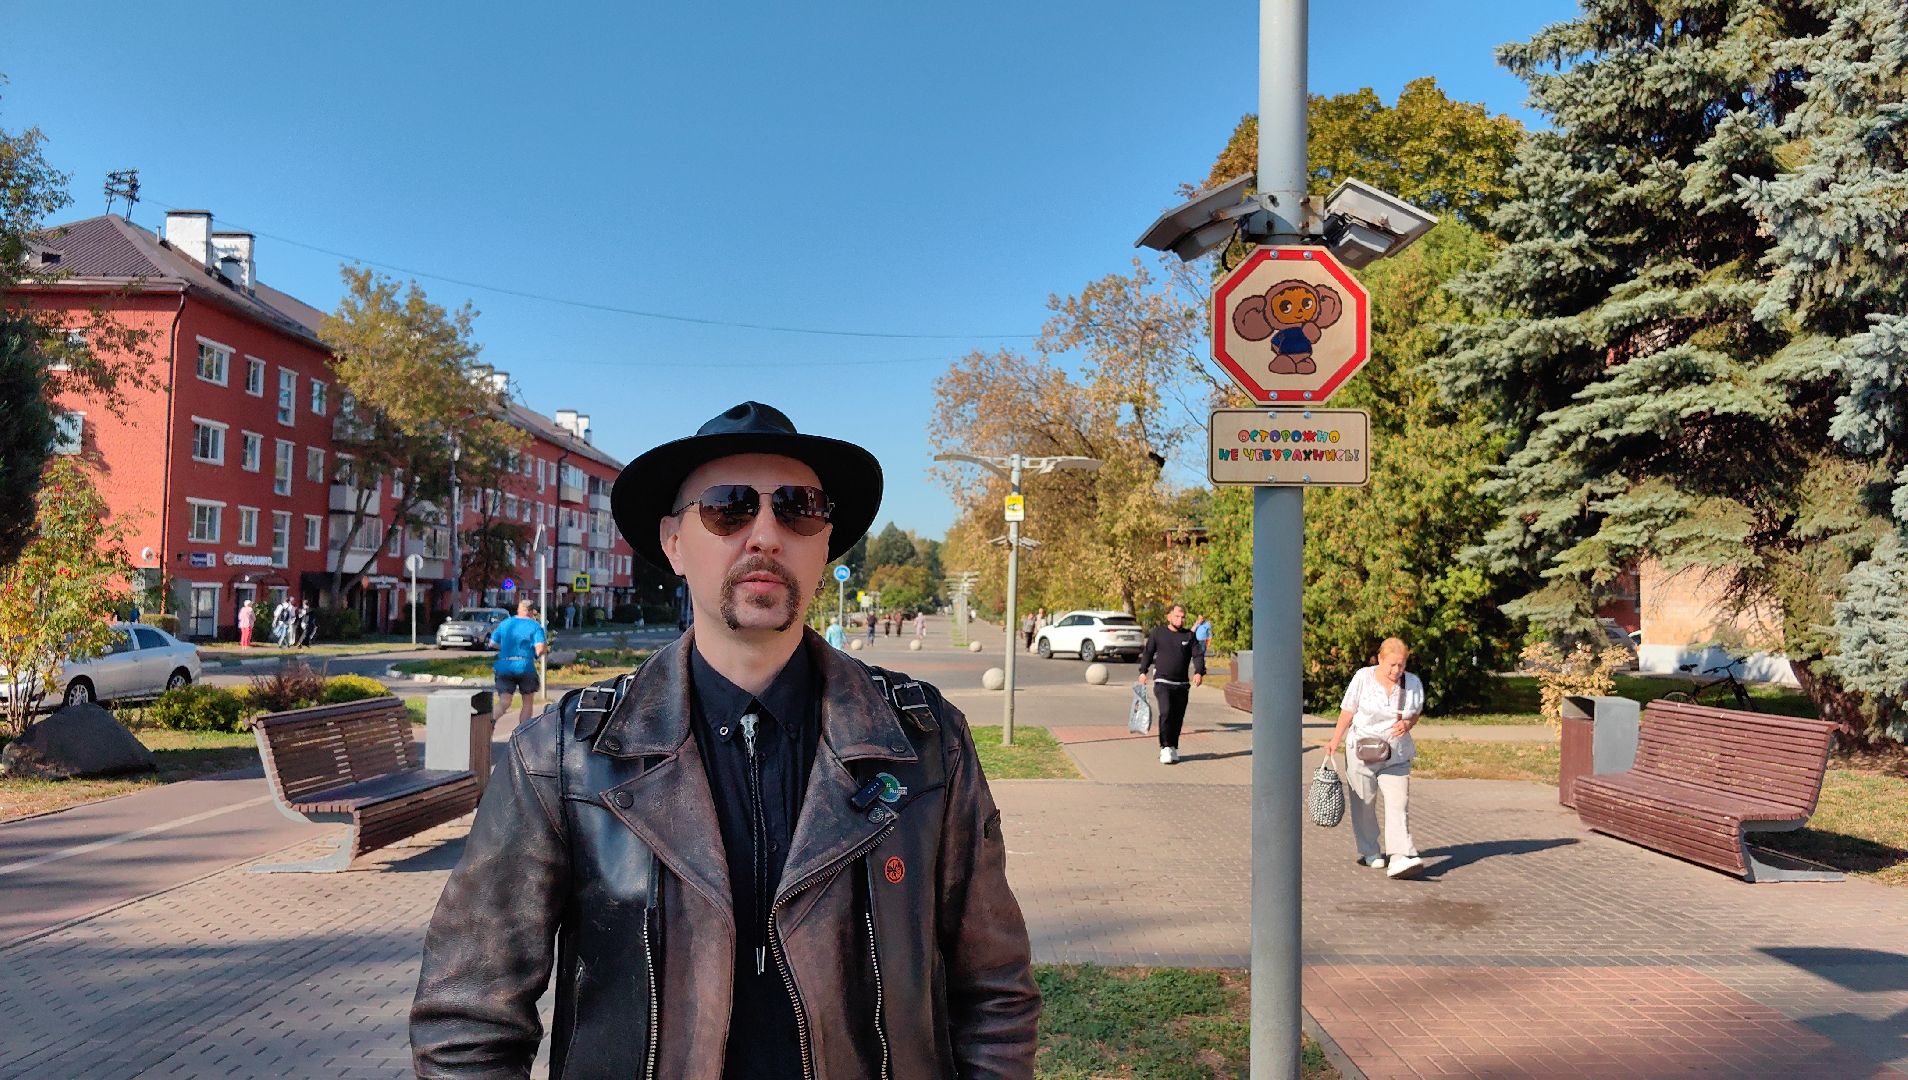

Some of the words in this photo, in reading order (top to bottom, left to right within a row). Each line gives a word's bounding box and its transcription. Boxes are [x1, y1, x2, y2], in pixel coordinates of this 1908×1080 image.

[1237, 429, 1341, 443] ОСТОРОЖНО
[1218, 448, 1239, 461] НЕ
[1243, 448, 1360, 461] ЧЕБУРАХНИСЬ!
